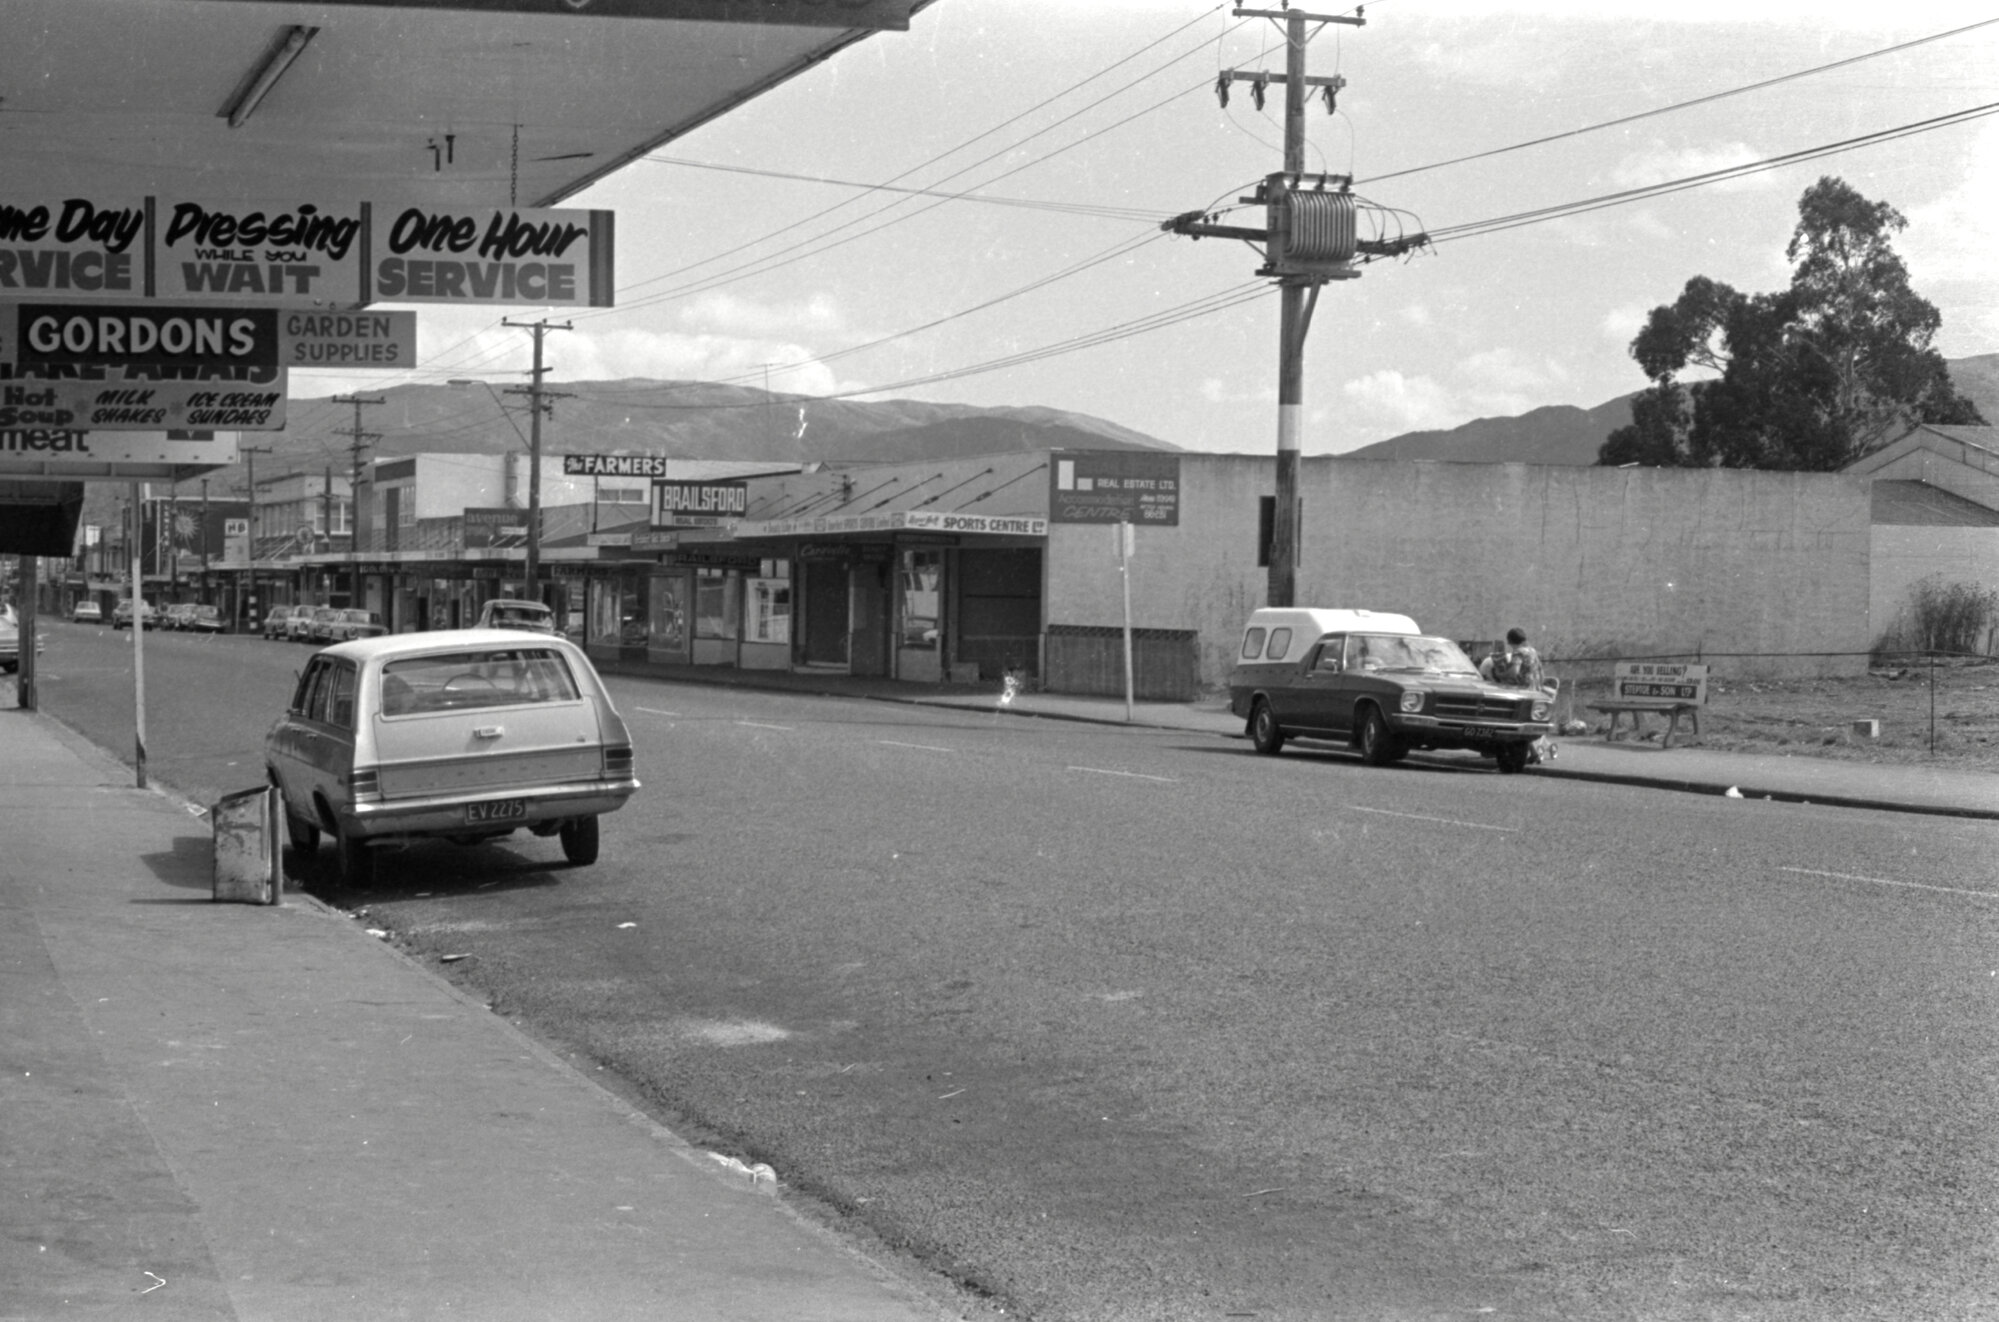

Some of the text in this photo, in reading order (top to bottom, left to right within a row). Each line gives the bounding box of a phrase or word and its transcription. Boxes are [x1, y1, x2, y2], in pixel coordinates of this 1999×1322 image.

[55, 199, 144, 254] Day
[165, 202, 360, 260] Pressing
[389, 208, 588, 261] One Hour
[195, 249, 307, 262] WHILE YOU
[181, 262, 320, 294] WAIT
[378, 257, 575, 300] SERVICE
[29, 316, 256, 356] GORDONS
[287, 315, 390, 338] GARDEN
[294, 342, 399, 361] SUPPLIES
[4, 386, 58, 406] Hot
[95, 390, 155, 405] MILK
[187, 392, 280, 408] ICE CREAM
[0, 407, 74, 426] Soup
[91, 408, 166, 424] SHAKES
[187, 409, 271, 425] SUNDAES
[584, 457, 665, 475] FARMERS
[1097, 478, 1120, 488] REAL
[1124, 479, 1156, 489] ESTATE
[664, 486, 745, 511] BRAILSFORD
[943, 517, 987, 530] SPORTS
[989, 519, 1029, 532] CENTRE
[1660, 686, 1676, 696] SON
